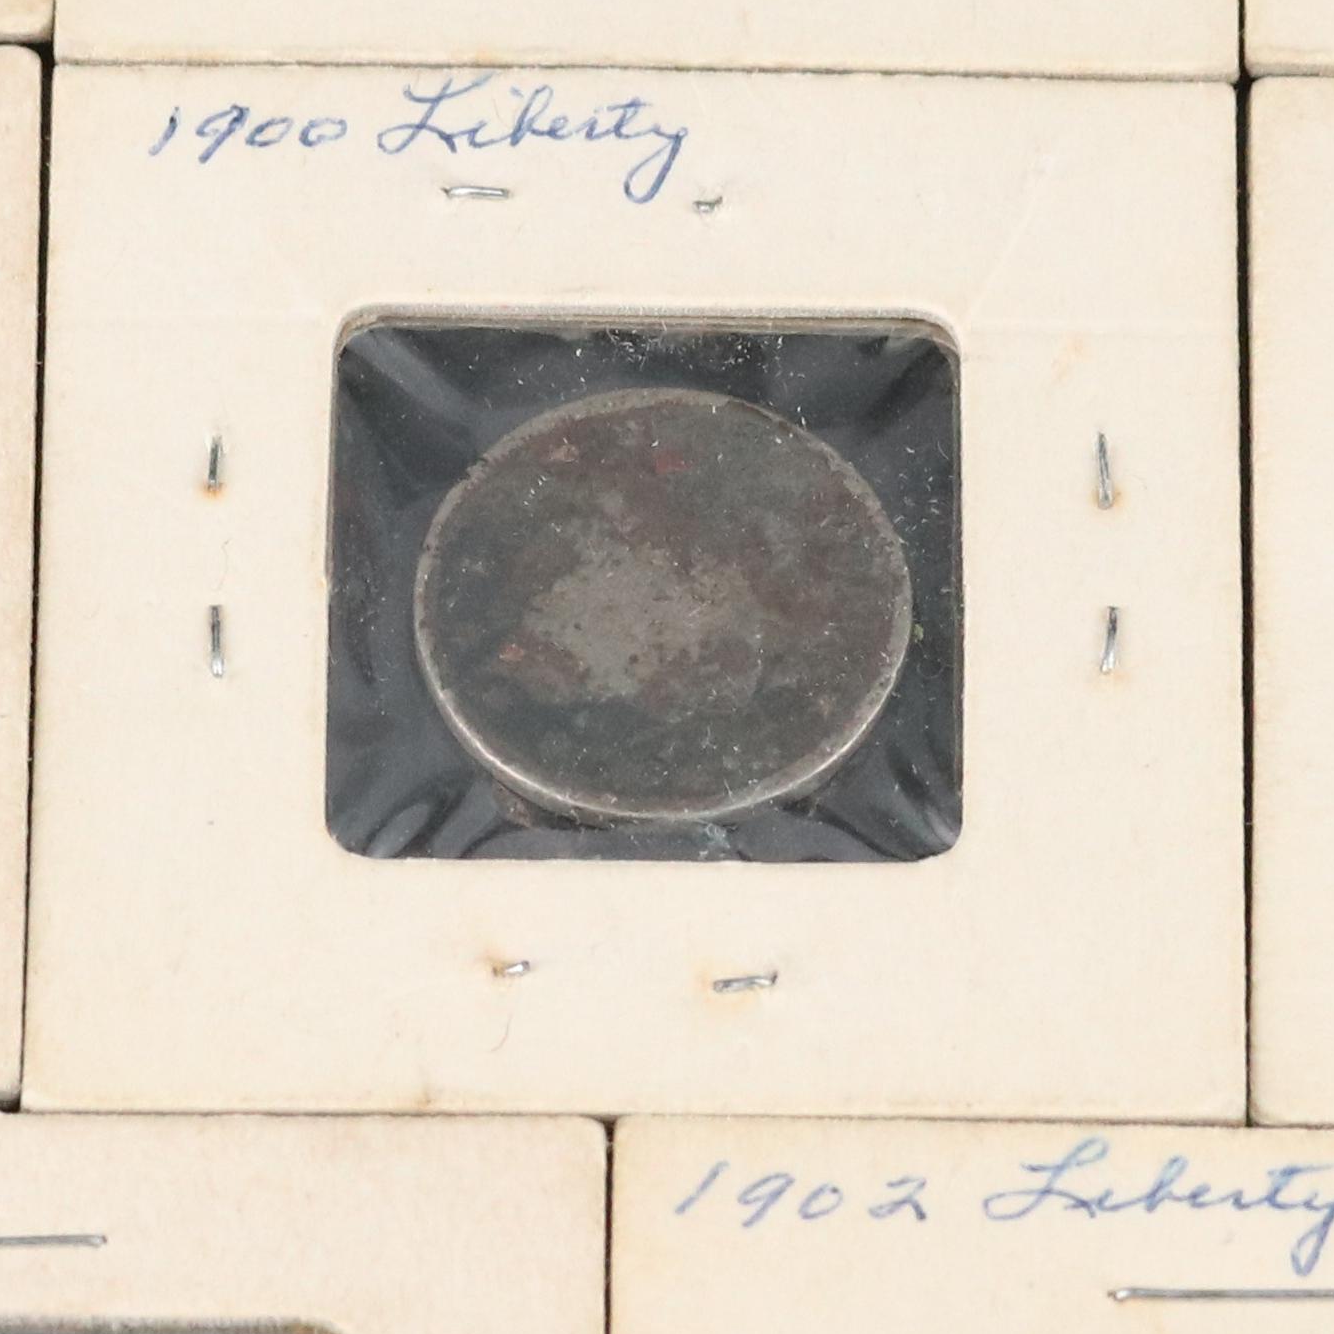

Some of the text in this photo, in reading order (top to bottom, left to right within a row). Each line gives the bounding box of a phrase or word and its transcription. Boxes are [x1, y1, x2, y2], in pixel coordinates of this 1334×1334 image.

[148, 73, 689, 205] 1900 Liberty
[673, 1161, 929, 1229] 1902
